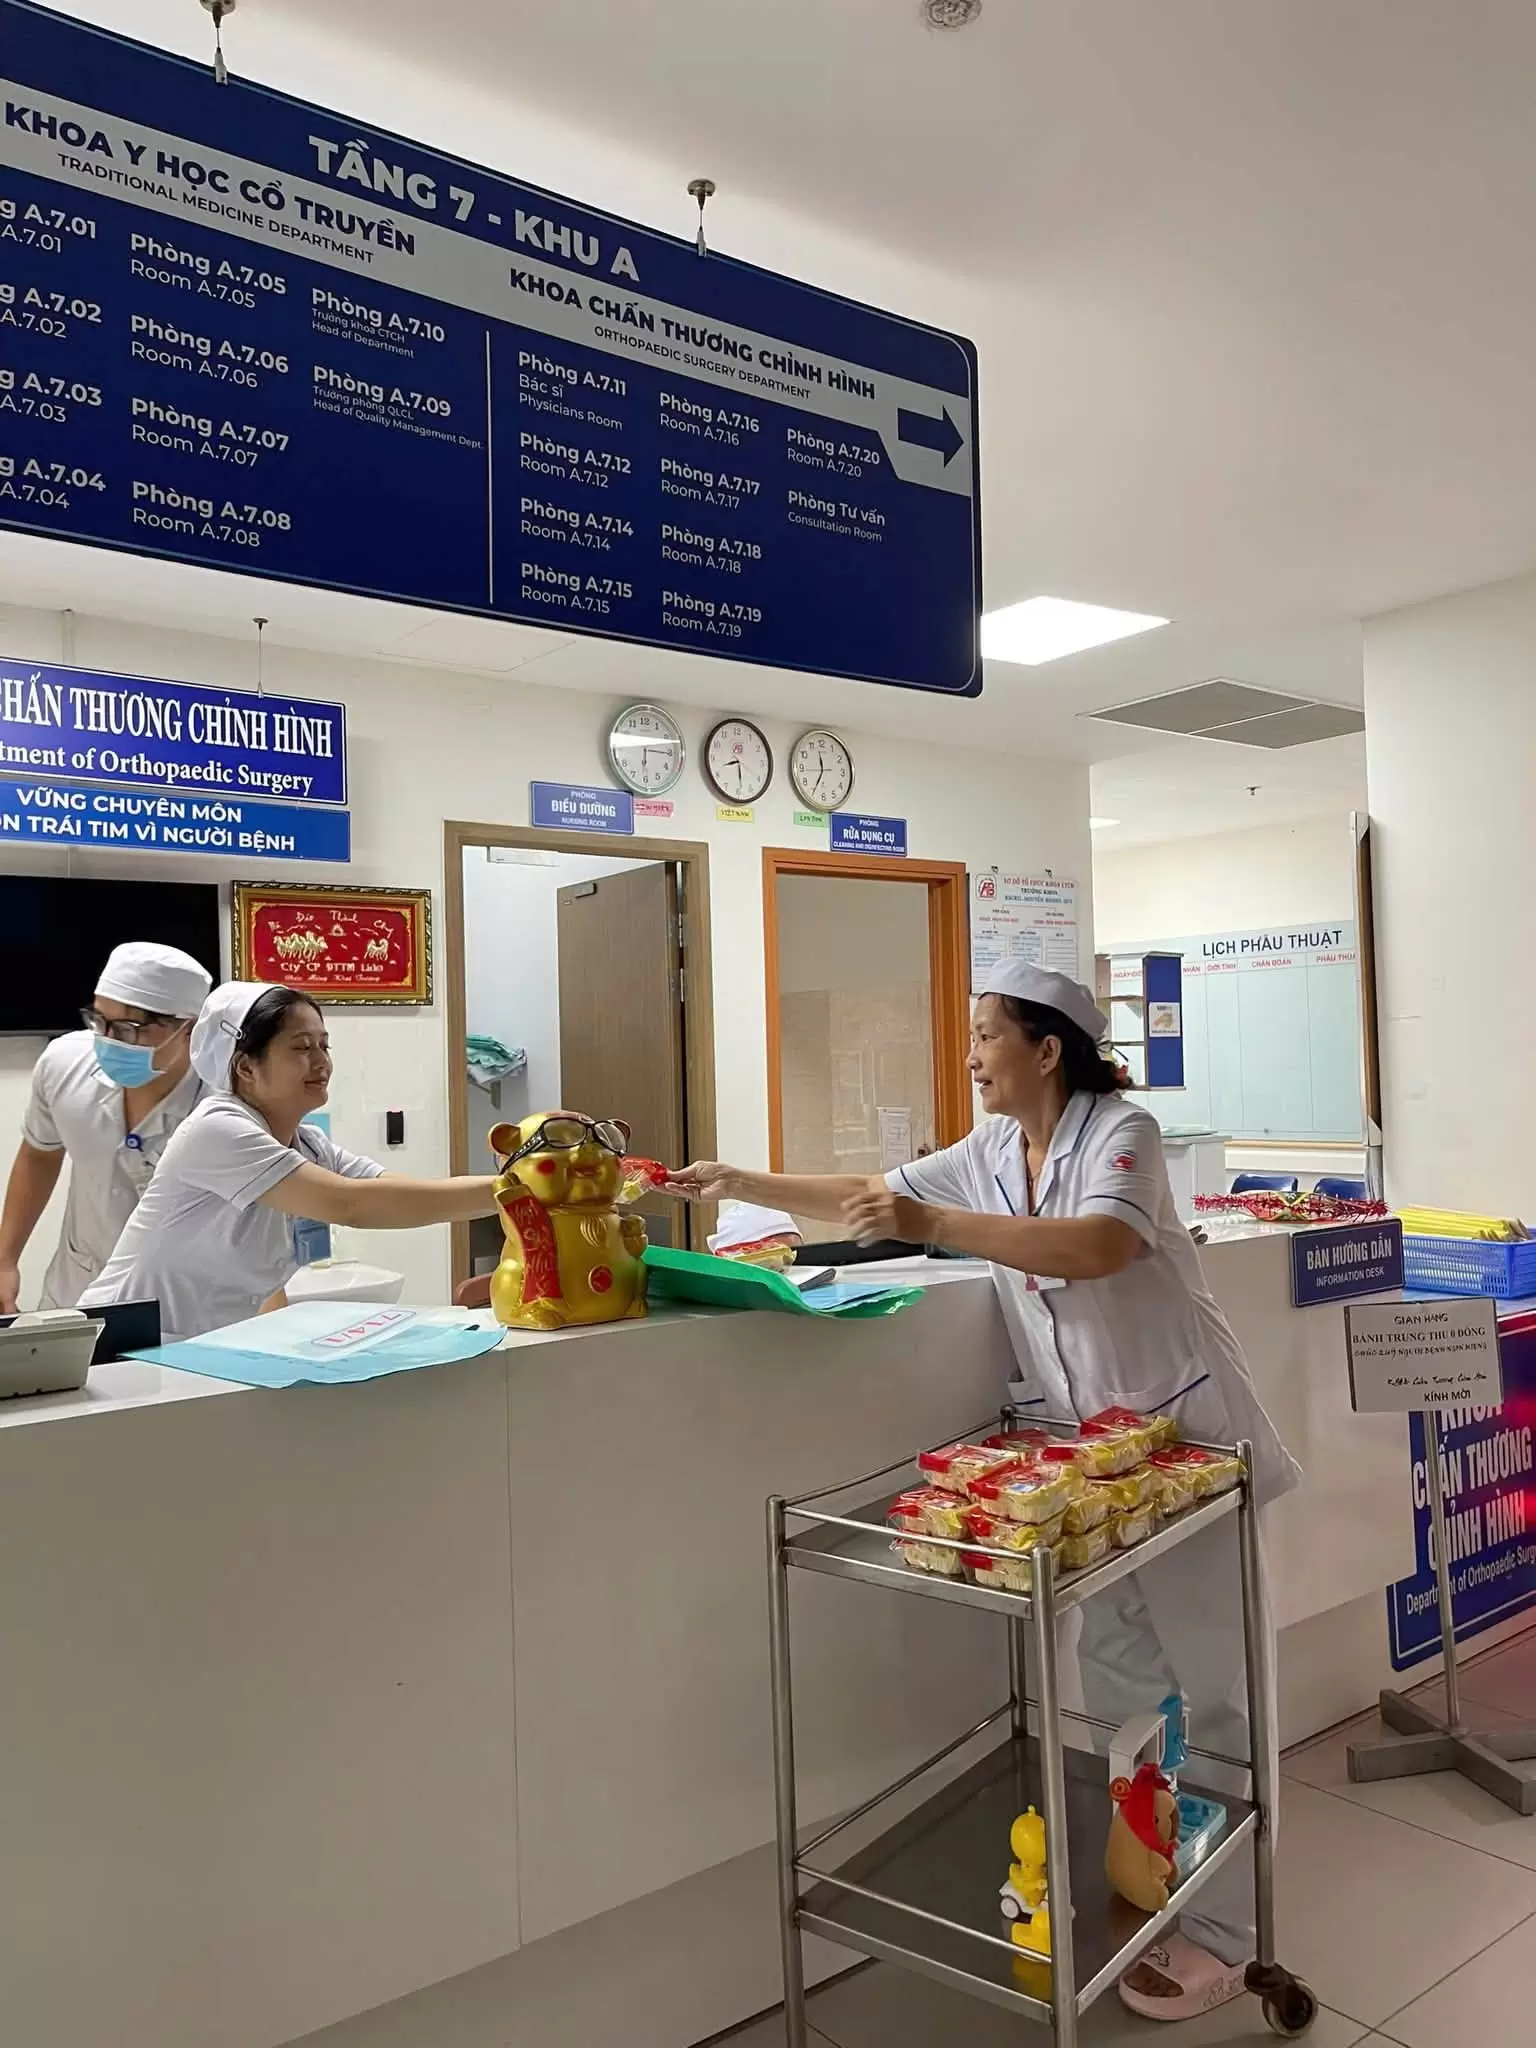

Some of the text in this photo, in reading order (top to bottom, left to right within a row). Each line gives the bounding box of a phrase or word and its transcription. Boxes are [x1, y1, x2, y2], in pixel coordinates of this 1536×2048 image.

[5, 101, 415, 255] KHOA Y HỌC CỔ TRUYỀN
[24, 204, 96, 239] A.7.01
[57, 153, 375, 263] TRADITIONAL MEDICINE DEPARTMENT
[309, 135, 436, 208] TẦNG
[450, 186, 475, 222] 7
[515, 209, 599, 266] KHU
[610, 247, 640, 281] A
[1, 224, 61, 253] A.7.01
[131, 233, 286, 294] Phòng A.7.05
[131, 259, 256, 308] Room A.7.05
[24, 287, 102, 323] A.7.02
[312, 288, 445, 342] Phòng A.7.10
[131, 315, 288, 373] Phòng A.7.06
[312, 322, 415, 359] Head of Department
[510, 268, 582, 309] KHOA
[589, 296, 655, 332] CHẤN
[661, 318, 752, 362] THƯƠNG
[828, 370, 875, 399] HÌNH
[132, 341, 258, 388] Room A.7.06
[519, 352, 626, 396] Phòng A.7.11
[594, 326, 811, 400] ORTHOPAEDIC SURGERY DEPARTMENT
[23, 372, 102, 407] A.7.03
[313, 365, 451, 417] Phòng A.7.09
[519, 373, 563, 398] Bác sĩ
[132, 398, 289, 451] Phòng A.7.07
[313, 399, 340, 413] Head
[343, 406, 353, 416] of
[355, 409, 391, 428] Quality
[393, 420, 457, 443] Management
[520, 392, 623, 431] Physicians Room
[660, 392, 760, 433] Phòng A.7.16
[133, 424, 258, 467] Room A.7.07
[520, 432, 631, 474] Phòng A.7.12
[787, 428, 880, 465] Phòng A.7.20
[787, 448, 862, 478] Room A.7.20
[24, 458, 106, 492] A.7.04
[520, 455, 608, 488] Room A.7.12
[661, 458, 760, 495] Phòng A.7.17
[133, 481, 292, 530] Phòng A.7.08
[521, 497, 634, 536] Phòng A.7.14
[788, 490, 885, 526] Phòng Tư vấn
[133, 508, 260, 547] Room A.7.08
[521, 520, 611, 551] Room A.7.14
[662, 524, 762, 559] Phòng A.7.18
[788, 512, 882, 542] Consultation Room
[521, 563, 633, 598] Phòng A.7.15
[522, 585, 610, 614] Room A.7.15
[662, 591, 762, 622] Phòng A.7.19
[0, 671, 333, 758] HẤN THƯƠNG CHỈNH HÌNH
[72, 747, 96, 770] of
[100, 750, 232, 785] Orthopaedic
[238, 765, 314, 796] Surgery
[16, 786, 242, 823] VỮNG CHUYÊN MÔN
[26, 815, 81, 836] TRÁI
[88, 820, 128, 840] TIM
[136, 821, 156, 841] VÌ
[164, 825, 232, 847] NGƯỜI
[239, 831, 295, 853] BỆNH
[1203, 930, 1342, 959] LỊCH PHẪU THUẬT
[1307, 1245, 1329, 1270] BÀN
[1332, 1240, 1368, 1266] HƯỚNG
[1316, 1266, 1384, 1287] INFORMATION DESK
[1386, 1331, 1425, 1342] TRUNG
[1429, 1330, 1448, 1341] THU
[1424, 1388, 1471, 1403] KÍNH MỜI
[1466, 1426, 1533, 1491] THƯƠNG
[1485, 1488, 1526, 1547] HÌNH
[1458, 1568, 1467, 1593] of
[1468, 1550, 1516, 1589] Orthopaedic
